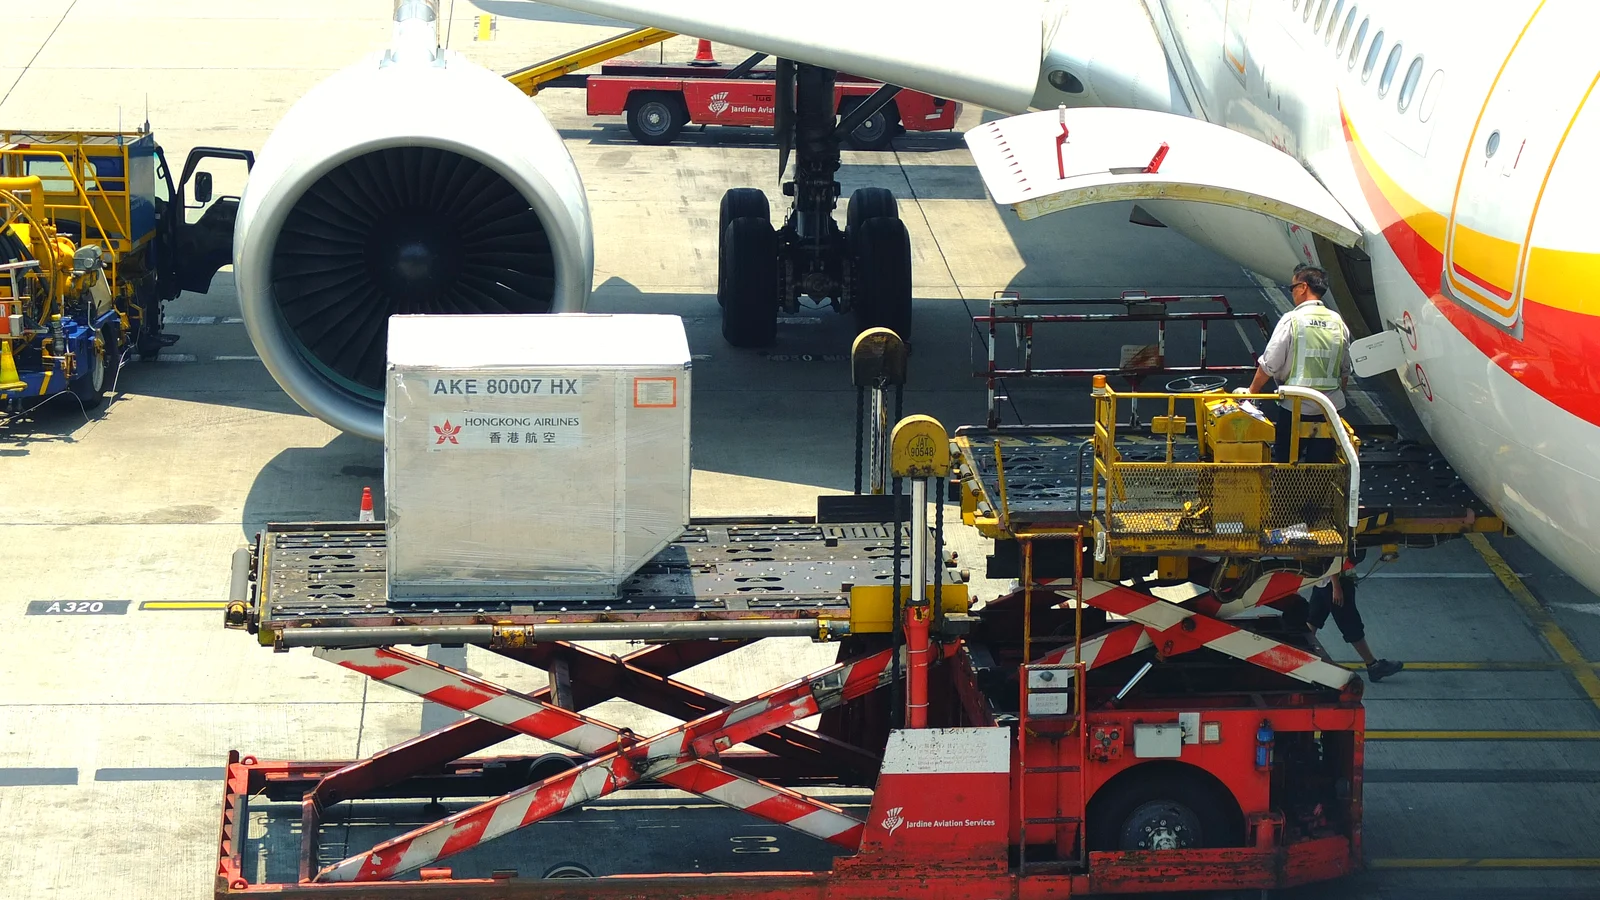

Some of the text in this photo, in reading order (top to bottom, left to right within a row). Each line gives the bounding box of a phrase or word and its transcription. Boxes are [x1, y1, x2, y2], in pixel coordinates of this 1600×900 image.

[1309, 319, 1327, 328] JATS
[433, 378, 578, 395] AKE 80007 HX
[464, 417, 580, 426] HONGKONG AIRLINES
[489, 431, 556, 444] 香港航空
[916, 437, 929, 447] JAT
[910, 447, 934, 457] 90548
[45, 601, 104, 613] A320
[906, 818, 996, 829] Jardine Aviation Services
